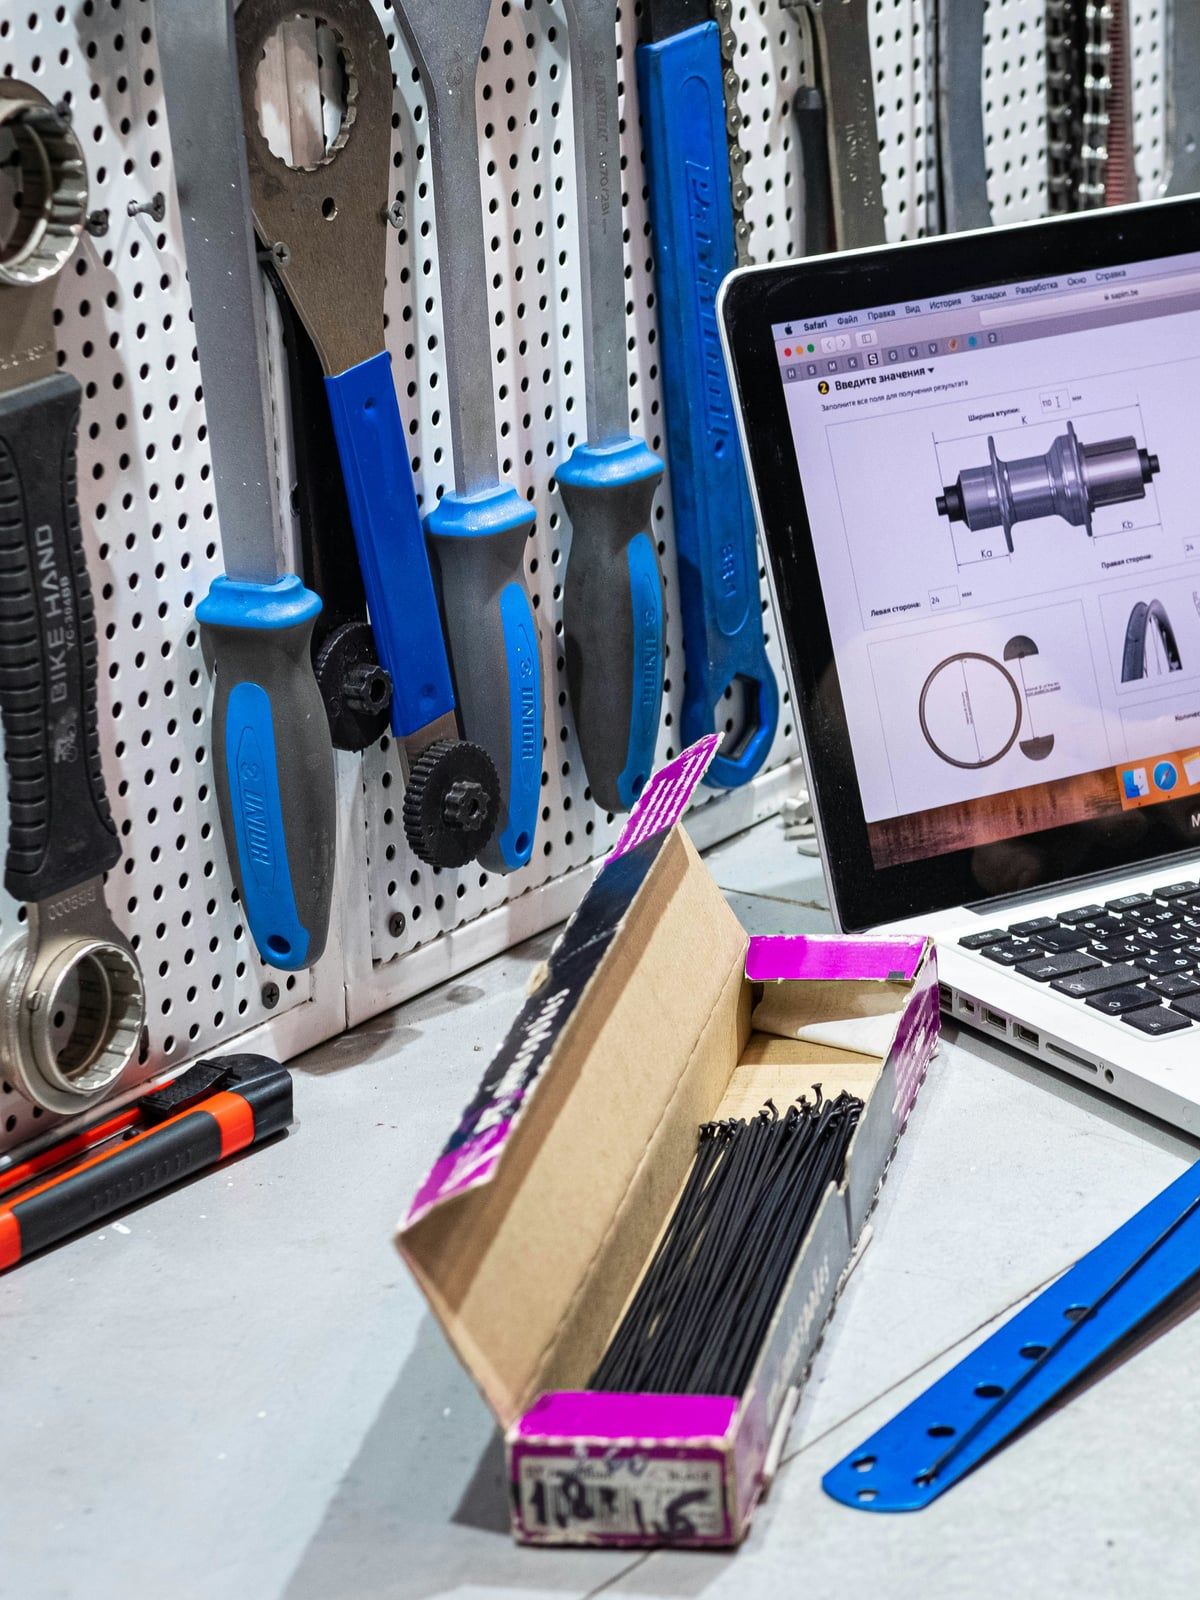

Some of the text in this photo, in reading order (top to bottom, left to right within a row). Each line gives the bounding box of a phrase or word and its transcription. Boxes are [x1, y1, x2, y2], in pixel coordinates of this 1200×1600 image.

[1067, 275, 1087, 286] Окно
[1095, 268, 1127, 282] Справка
[1015, 280, 1059, 296] Разработка
[1110, 288, 1139, 300] sapim.be
[970, 288, 1007, 304] Закладки
[905, 304, 921, 315] Вид
[929, 297, 962, 311] История
[837, 314, 859, 326] Файл
[867, 308, 896, 321] Правка
[803, 319, 828, 332] Safari
[834, 375, 877, 392] Введите
[879, 366, 926, 384] значения
[821, 379, 969, 412] Заполните все поля для получения результата
[1122, 519, 1134, 530] Kb
[980, 548, 993, 560] Ka
[1101, 559, 1125, 570] Правая
[930, 595, 940, 605] 24
[35, 524, 67, 703] BIKE HAND
[870, 606, 891, 618] Левая
